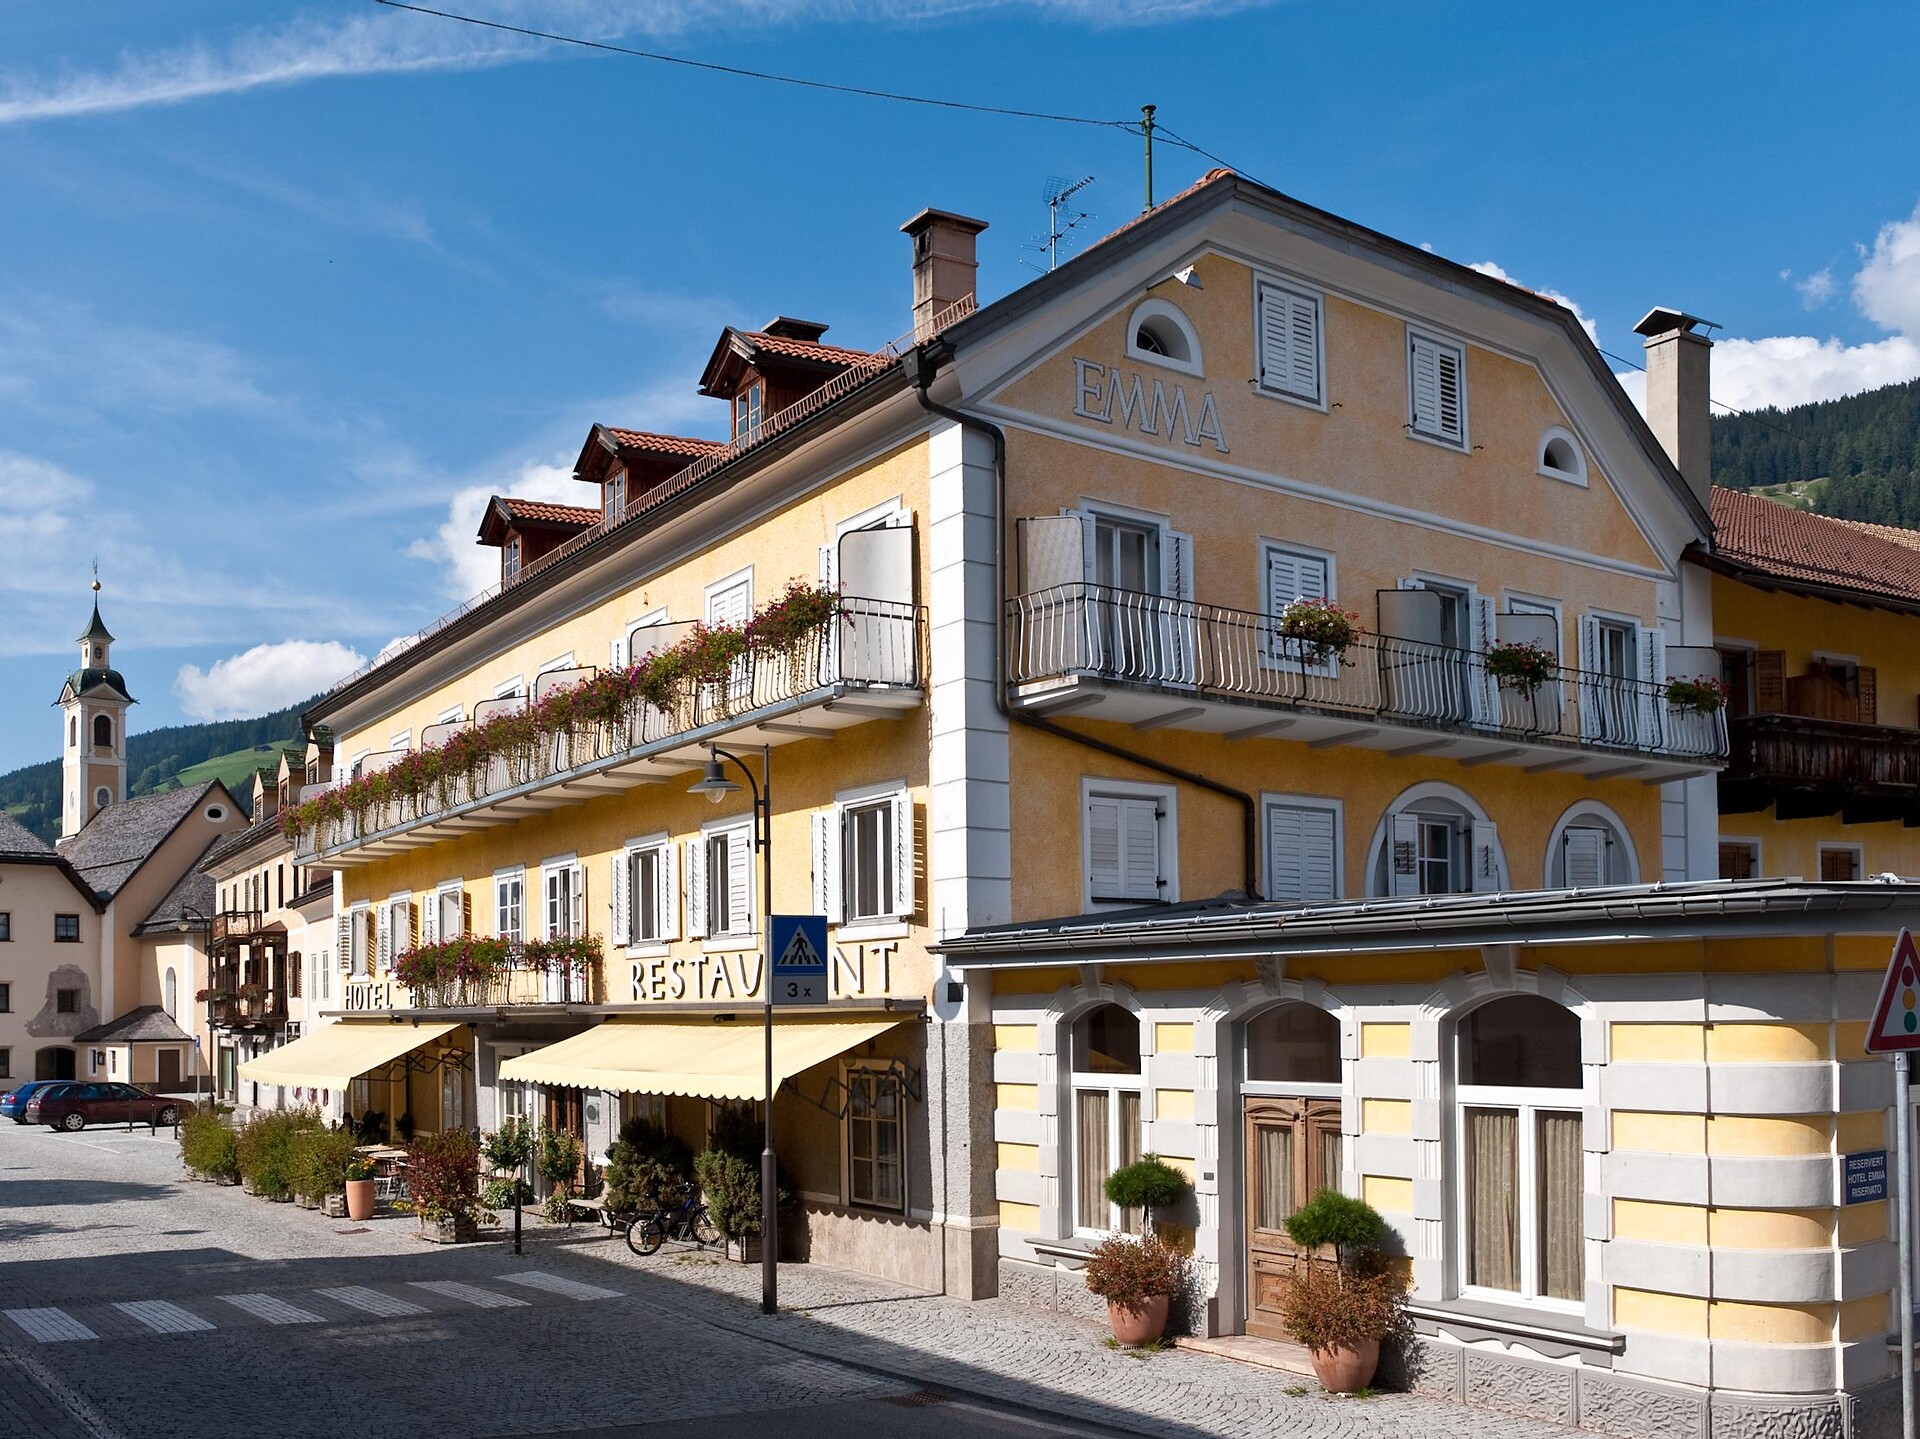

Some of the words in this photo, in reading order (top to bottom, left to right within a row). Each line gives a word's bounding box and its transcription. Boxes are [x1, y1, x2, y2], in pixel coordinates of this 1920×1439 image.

[1073, 357, 1230, 453] EMMA
[630, 942, 898, 1000] RESTAUNT
[345, 983, 393, 1010] HOTEL
[787, 982, 798, 998] 3
[1849, 1157, 1883, 1169] RESERVIERT
[1847, 1173, 1867, 1184] HOTEL
[1868, 1171, 1885, 1181] EMMA
[1851, 1184, 1881, 1197] RISERVATO
